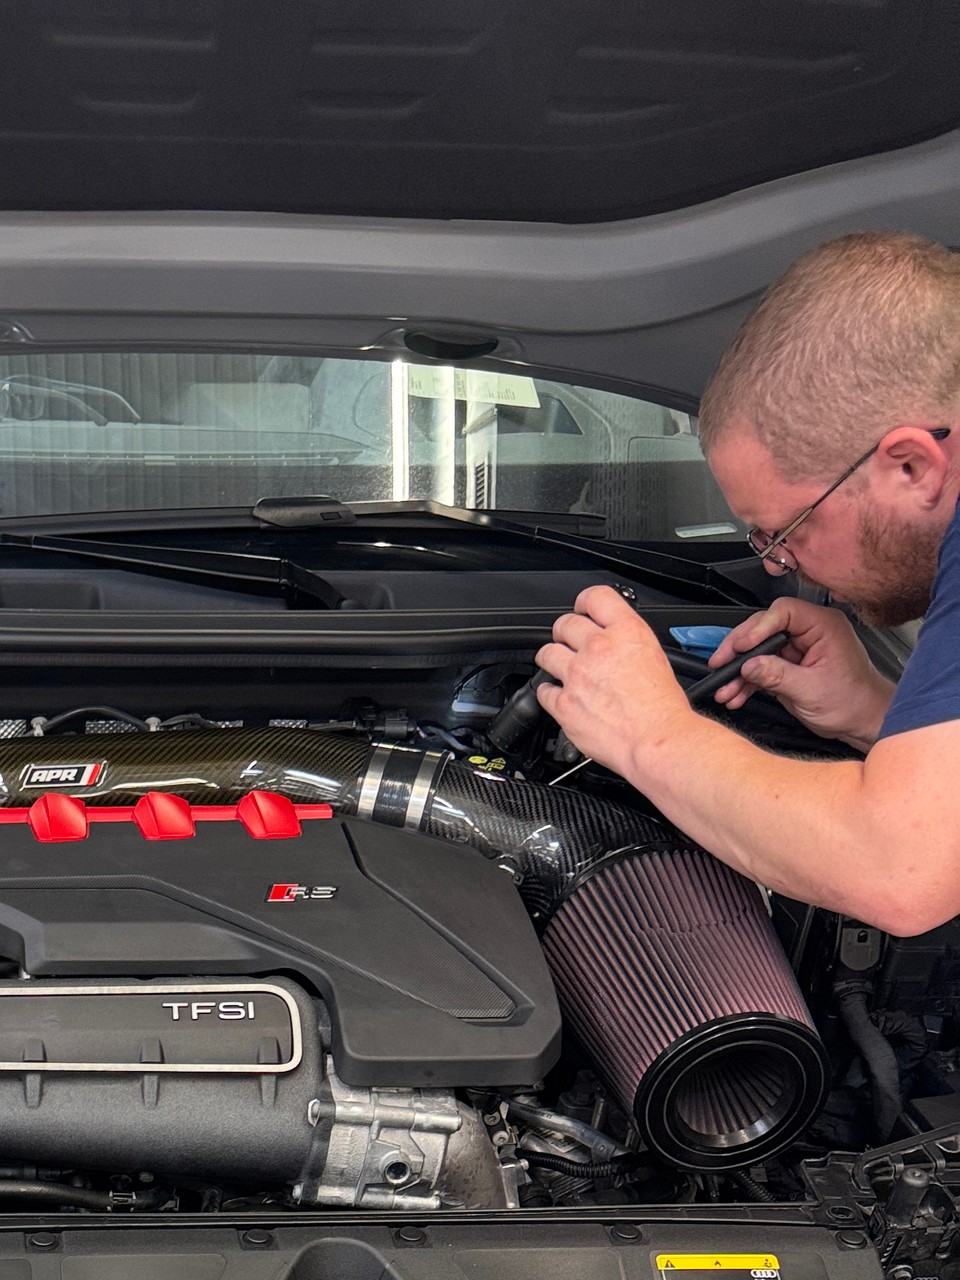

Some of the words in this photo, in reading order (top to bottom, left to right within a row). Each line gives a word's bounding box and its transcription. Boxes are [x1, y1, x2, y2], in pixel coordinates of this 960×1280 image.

[30, 769, 78, 782] APR
[273, 885, 337, 900] RS
[162, 1002, 255, 1020] TFSI
